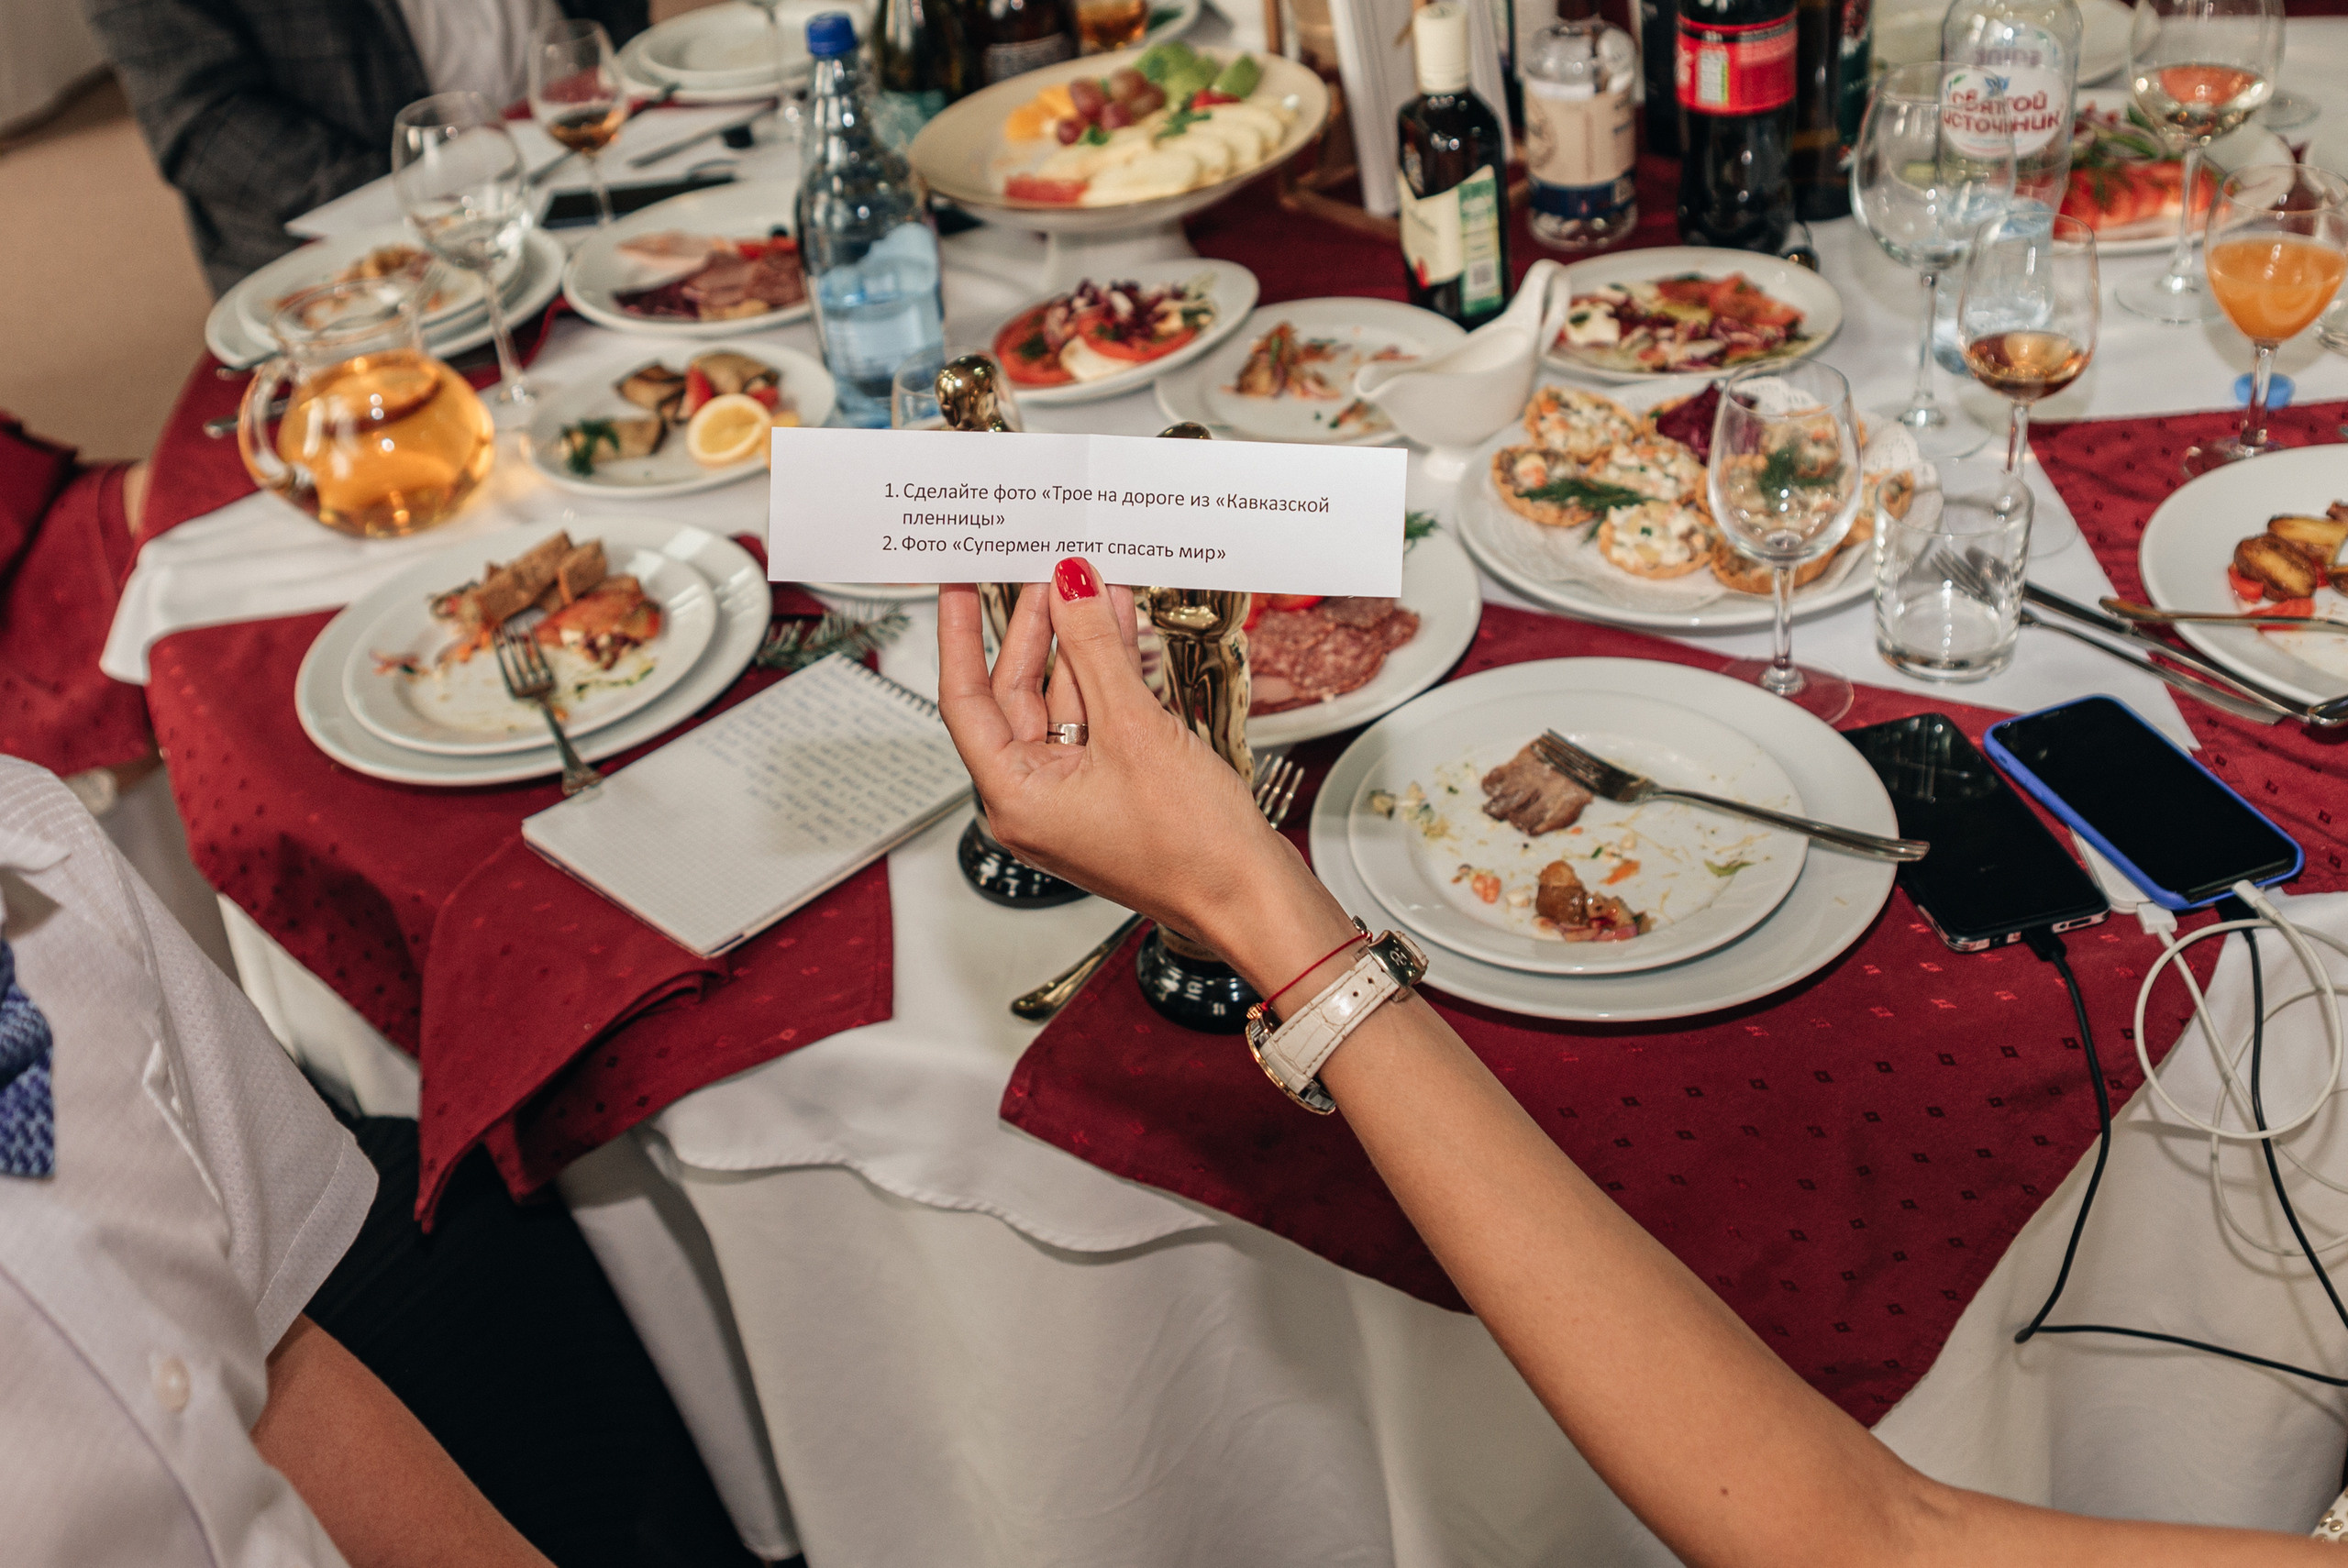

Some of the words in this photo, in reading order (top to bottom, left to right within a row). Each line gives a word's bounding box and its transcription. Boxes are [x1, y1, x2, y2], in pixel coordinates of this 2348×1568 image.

[885, 482, 899, 498] 1.
[903, 482, 989, 502] Сделайте
[993, 483, 1036, 503] фото
[1042, 485, 1092, 504] «Трое
[1098, 490, 1117, 502] на
[1122, 491, 1185, 508] дороге
[1191, 495, 1210, 508] из
[1215, 493, 1330, 513] «Кавказской
[903, 513, 1005, 529] пленницы»
[882, 535, 897, 551] 2.
[902, 535, 947, 552] Фото
[952, 536, 1051, 556] «Супермен
[1055, 540, 1104, 553] летит
[1107, 542, 1175, 558] спасать
[1179, 547, 1227, 564] мир»
